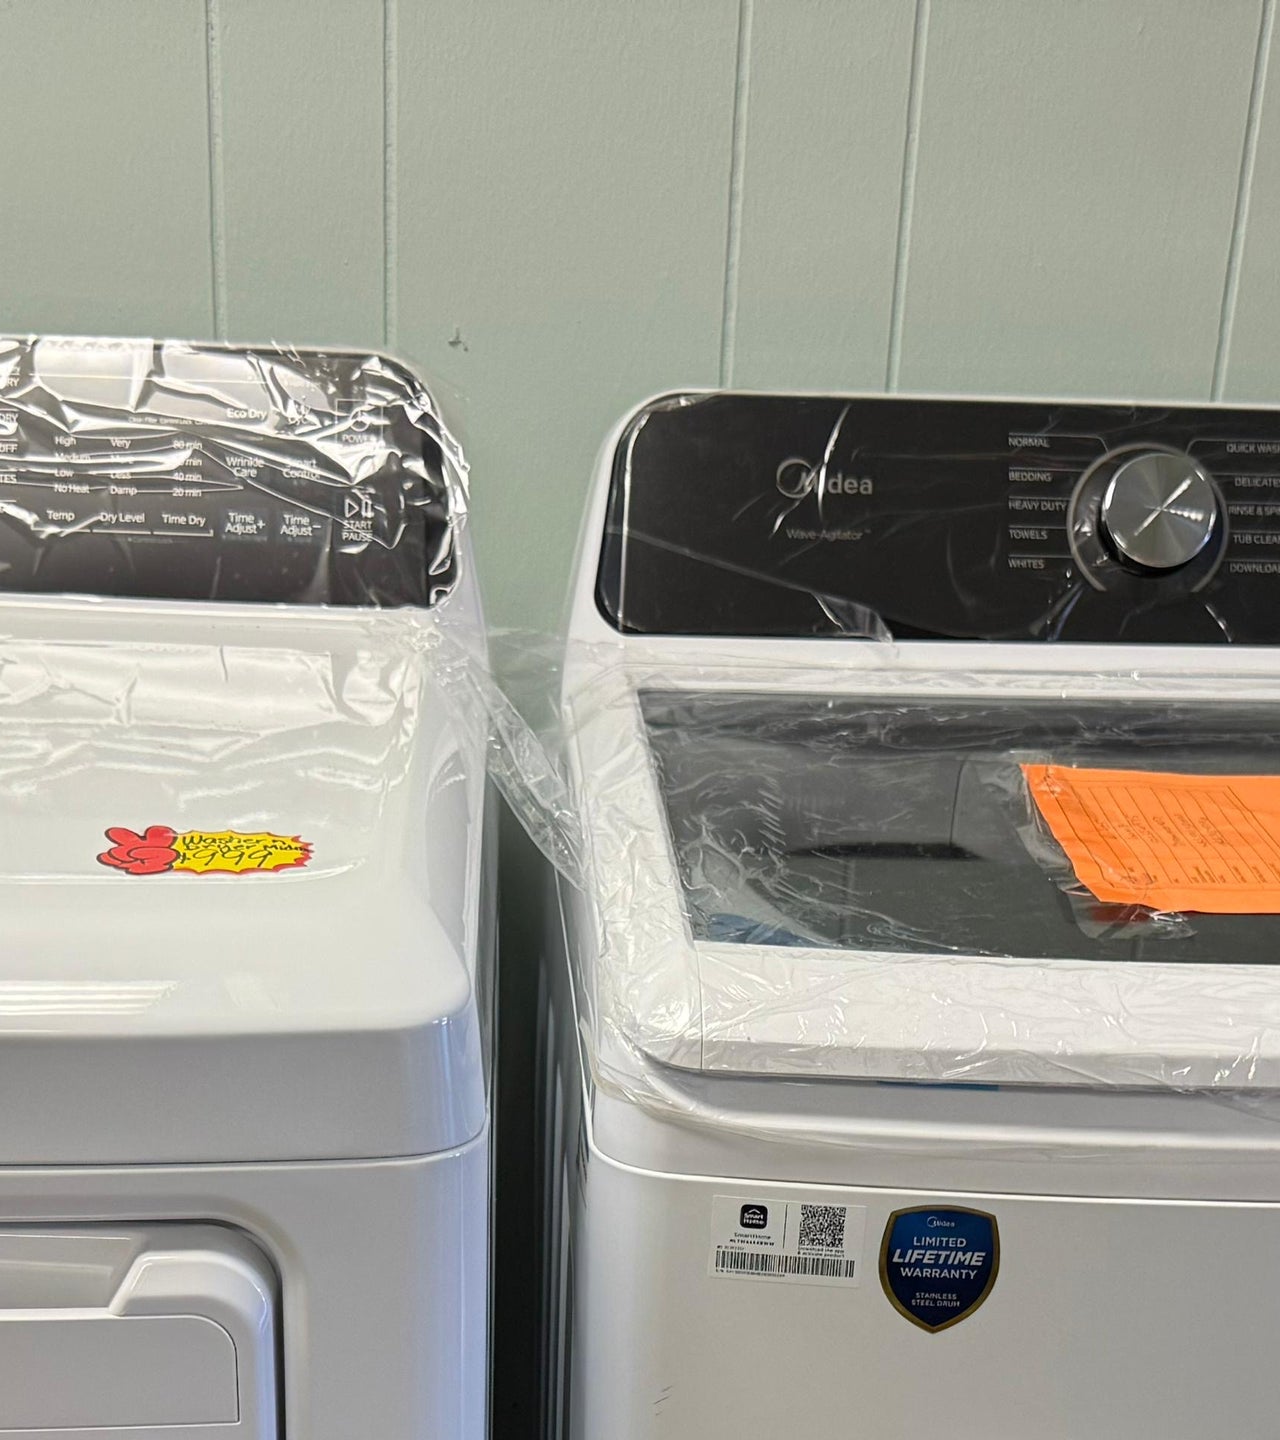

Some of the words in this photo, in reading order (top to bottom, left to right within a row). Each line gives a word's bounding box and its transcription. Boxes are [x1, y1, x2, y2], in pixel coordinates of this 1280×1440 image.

[227, 410, 247, 419] Eco
[249, 410, 267, 420] Dry
[55, 436, 76, 446] High
[111, 439, 131, 449] Very
[1008, 437, 1050, 448] NORMAL
[1226, 443, 1256, 453] QUICK
[185, 458, 202, 466] min
[1009, 471, 1052, 482] BEDDING
[110, 486, 137, 495] Damp
[186, 489, 202, 497] min
[1009, 501, 1040, 510] HEAVY
[1041, 502, 1066, 511] DUTY
[1229, 505, 1256, 516] RINSE
[47, 509, 75, 521] Temp
[100, 513, 117, 524] Dry
[119, 513, 145, 523] Level
[162, 514, 186, 525] Time
[188, 515, 206, 526] Dry
[228, 512, 255, 523] Time
[284, 514, 310, 525] Time
[343, 520, 372, 529] START
[342, 532, 372, 542] PAUSE
[1009, 529, 1048, 540] TOWELS
[1233, 535, 1252, 544] TUB
[1008, 559, 1045, 569] WHITES
[913, 1236, 967, 1247] LIMITED
[892, 1249, 987, 1266] LIFETIME
[900, 1267, 978, 1280] WARRANTY
[915, 1292, 957, 1301] STAINLESS
[911, 1298, 936, 1307] STEEL
[937, 1300, 960, 1308] DRUM
